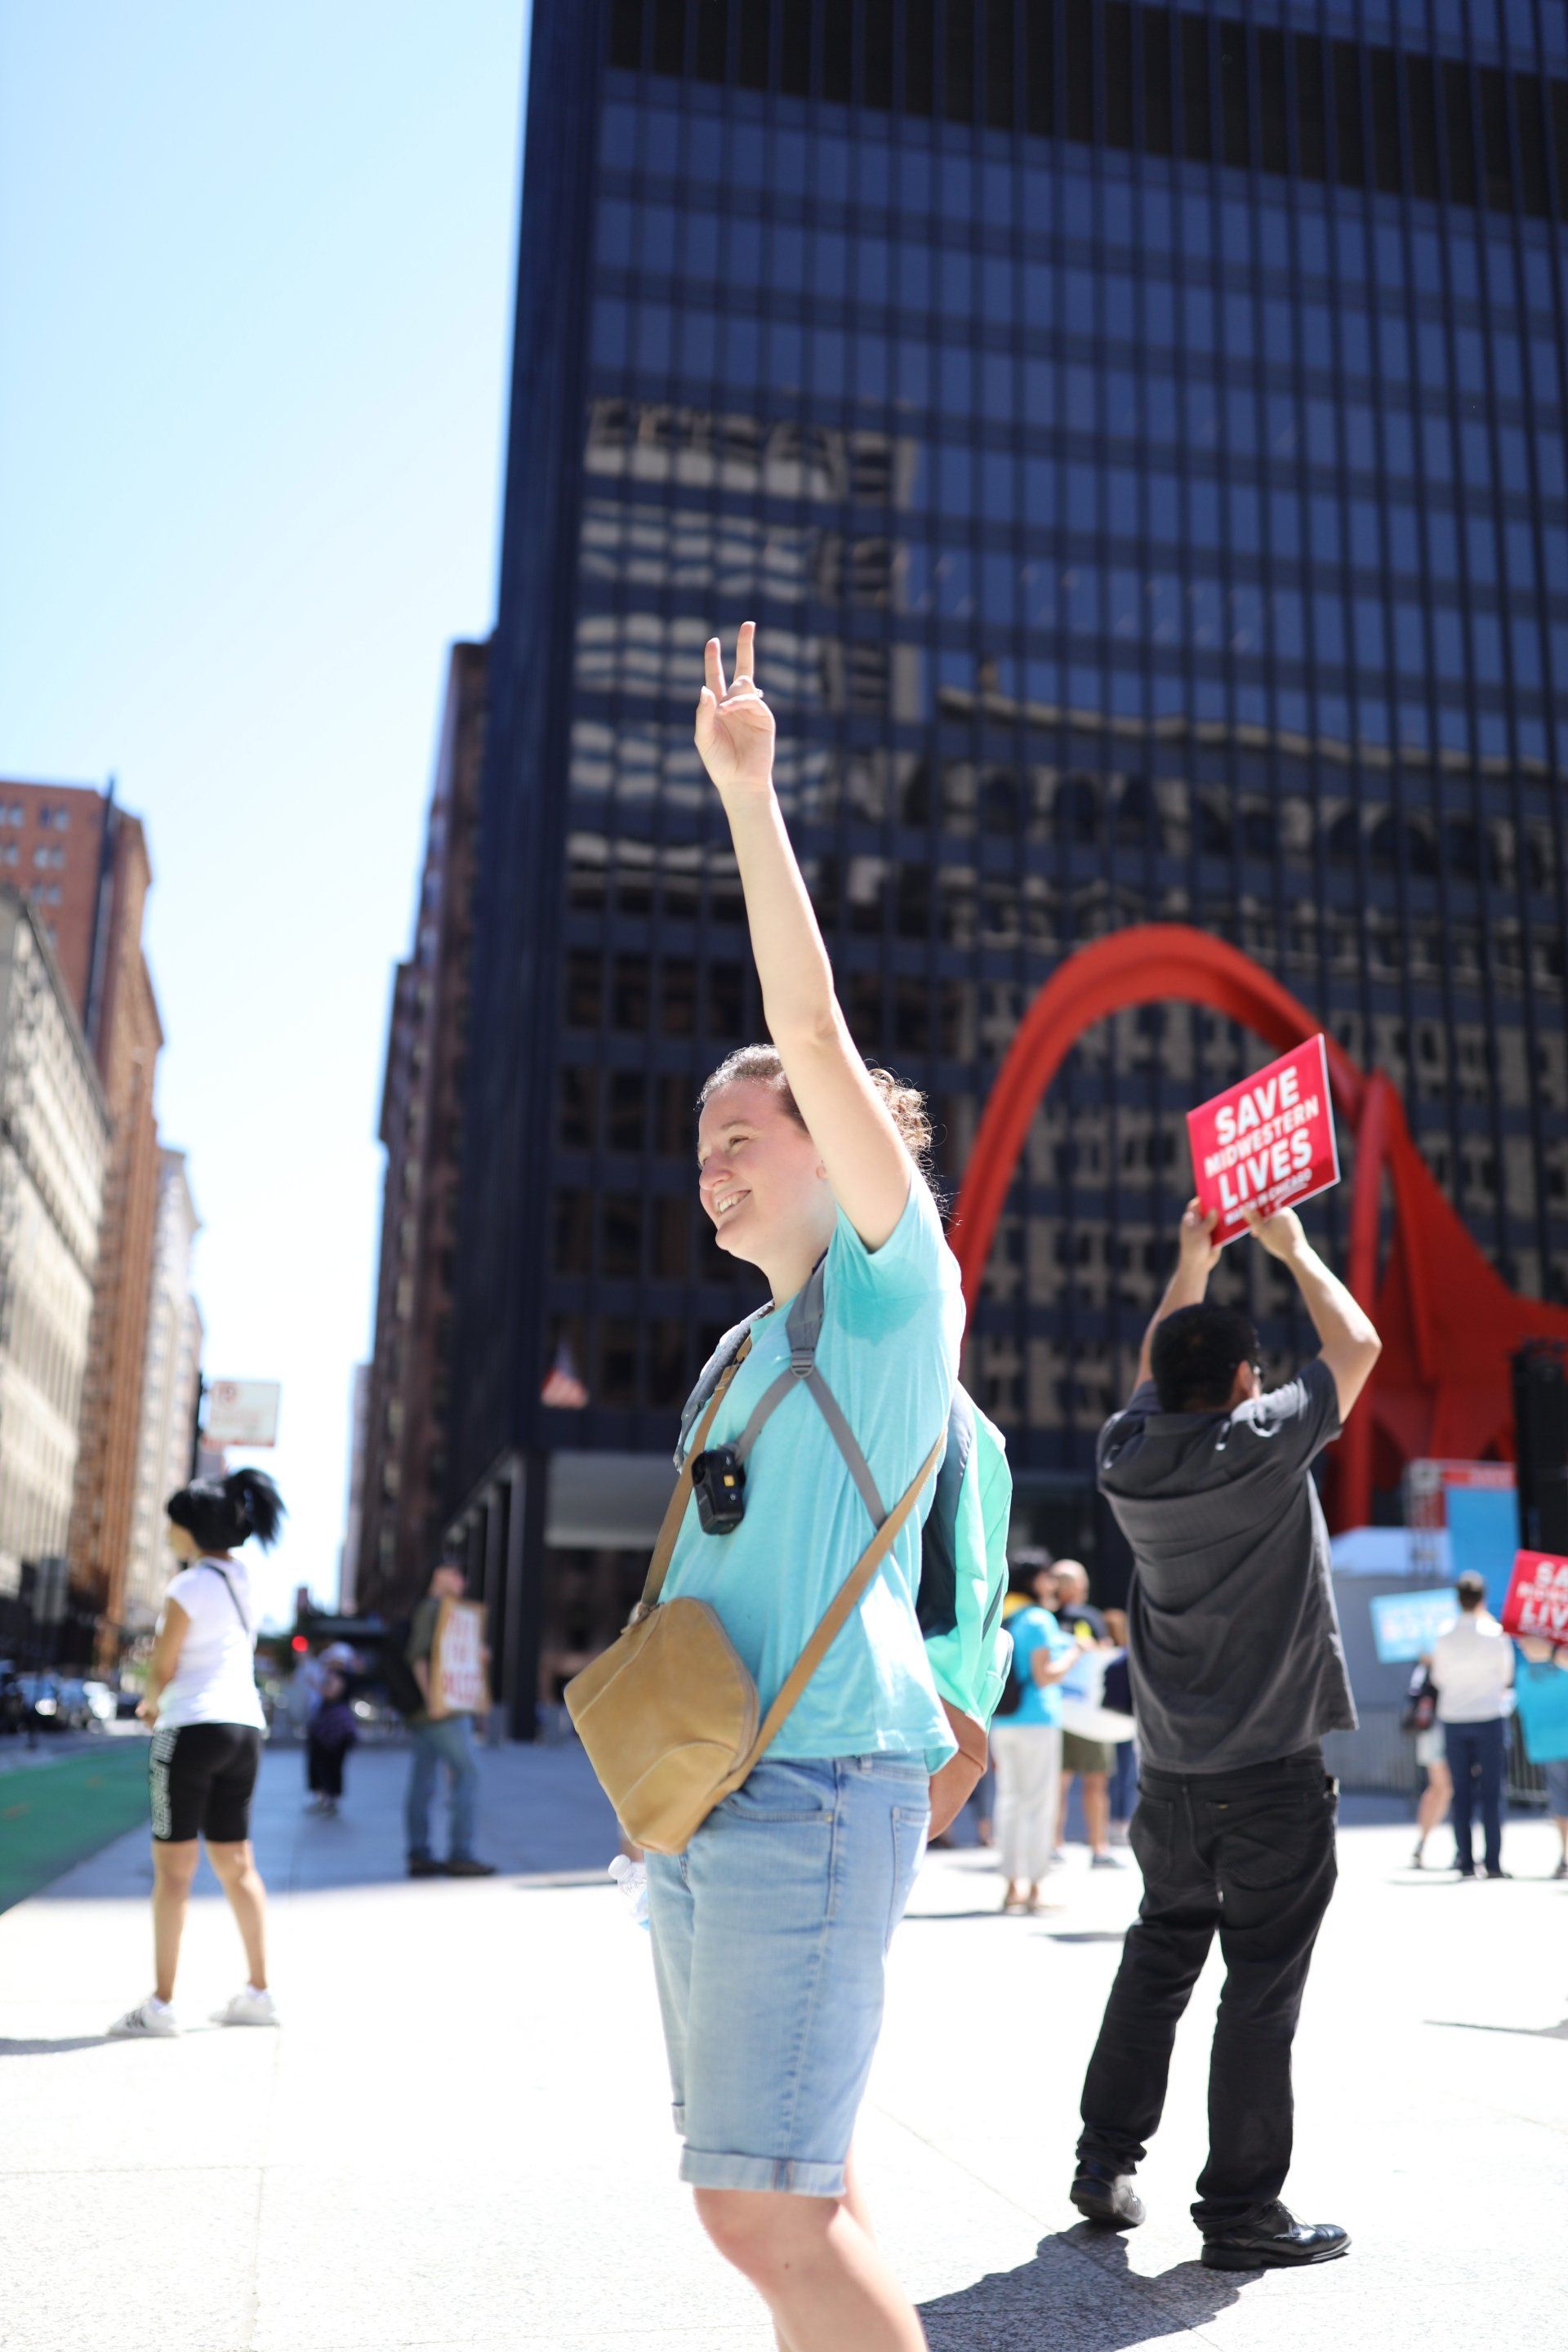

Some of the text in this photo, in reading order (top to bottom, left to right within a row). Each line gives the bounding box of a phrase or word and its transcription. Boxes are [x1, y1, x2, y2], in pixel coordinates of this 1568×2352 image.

[1203, 1094, 1320, 1178] MIDWESTERN
[1214, 1065, 1300, 1147] SAVE
[1218, 1127, 1312, 1210] LIVES
